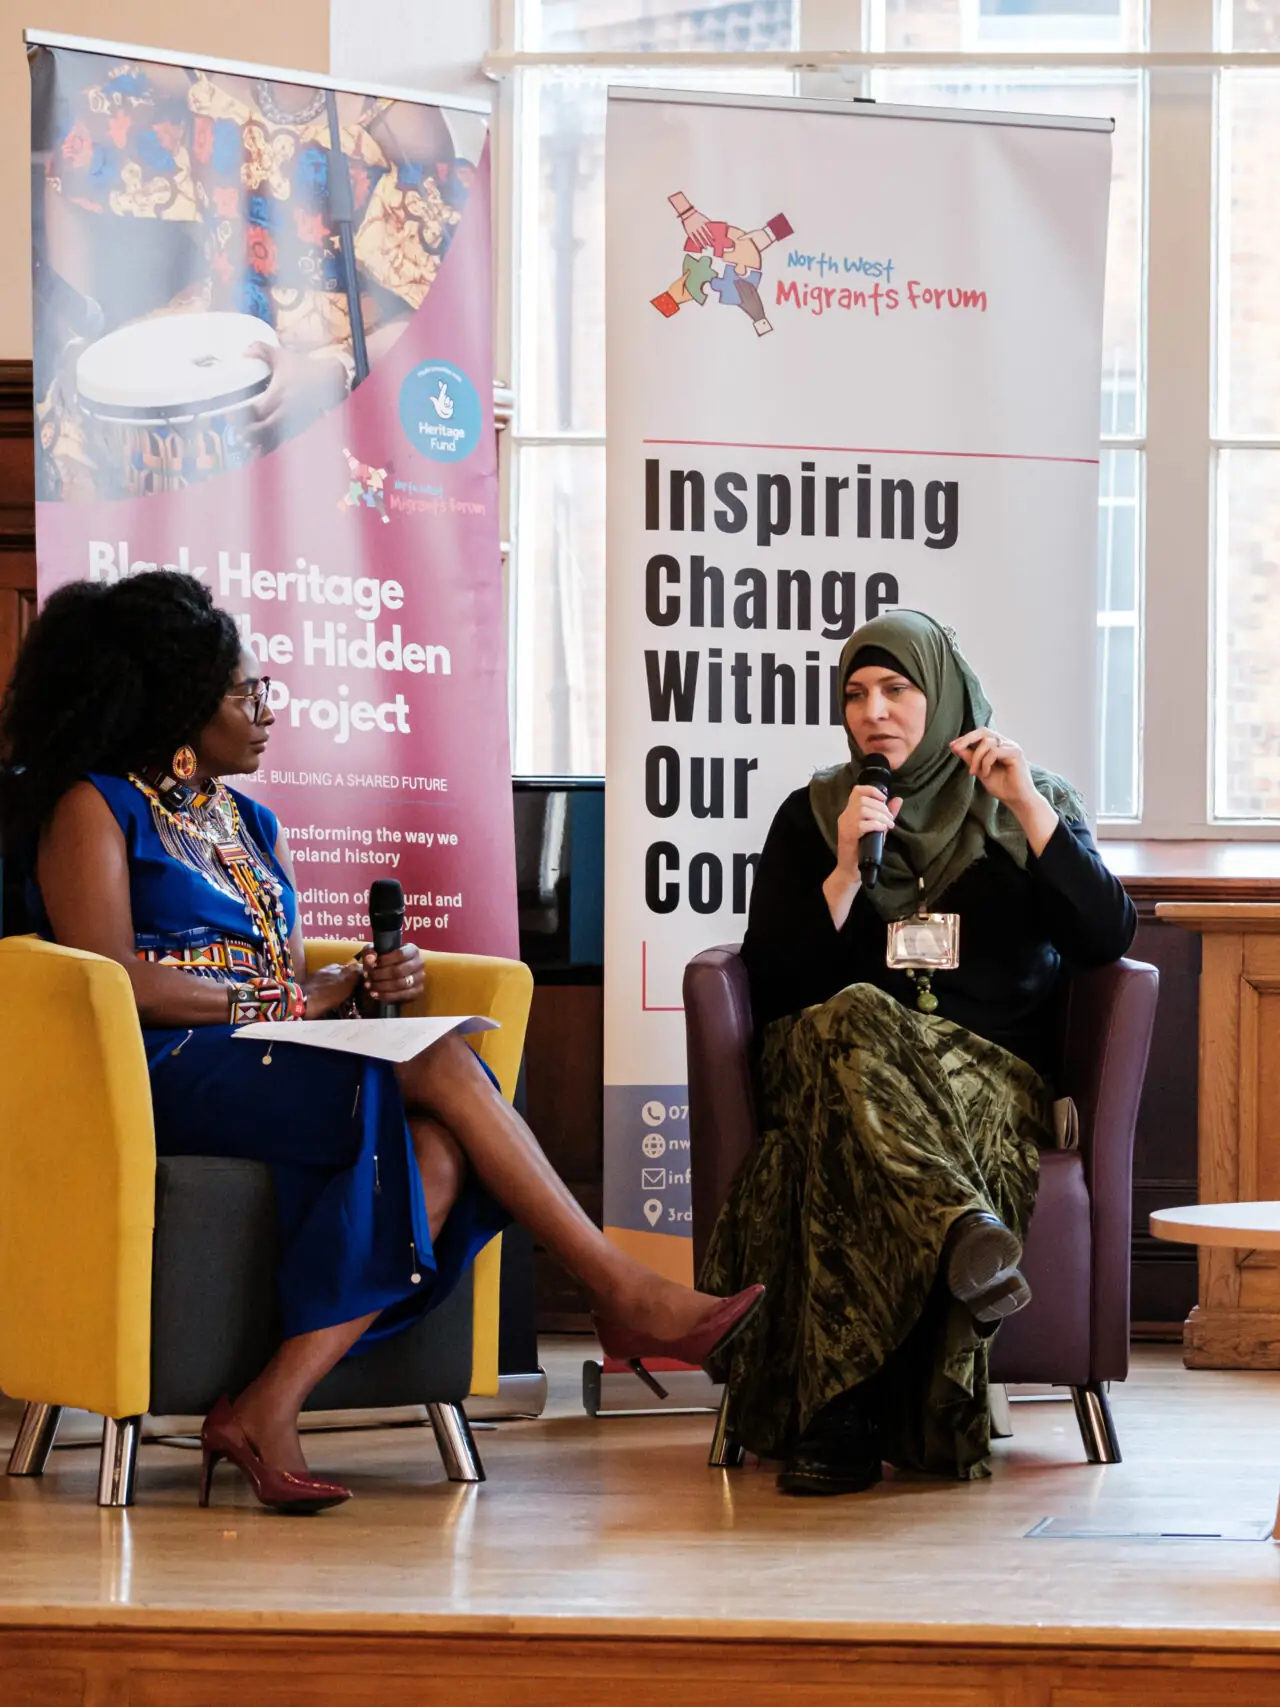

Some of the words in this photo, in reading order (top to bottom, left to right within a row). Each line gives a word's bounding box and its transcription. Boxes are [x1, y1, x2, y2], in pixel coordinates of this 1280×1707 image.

[787, 249, 839, 278] North
[843, 256, 895, 283] West
[775, 279, 899, 317] Migrants
[907, 280, 988, 312] Forum
[418, 421, 466, 441] Heritage
[430, 438, 457, 452] Fund
[644, 458, 960, 549] Inspiring
[218, 551, 405, 621] Heritage
[644, 554, 900, 640] Change
[303, 620, 452, 675] Hidden
[262, 680, 411, 744] Project
[270, 769, 333, 786] BUILDING
[334, 773, 345, 786] A
[346, 773, 399, 789] SHARED
[401, 776, 448, 792] FUTURE
[644, 745, 758, 820] Our
[282, 824, 373, 845] ansforming
[376, 826, 402, 843] the
[404, 831, 434, 848] way
[436, 832, 459, 846] we
[290, 847, 341, 863] reland
[345, 847, 400, 868] history
[296, 887, 349, 904] adition
[353, 888, 370, 904] of
[403, 891, 433, 906] ural
[435, 892, 462, 908] and
[316, 910, 343, 926] the
[434, 913, 449, 929] of
[668, 1104, 689, 1120] 07
[668, 1139, 691, 1150] nw
[668, 1167, 692, 1185] inf
